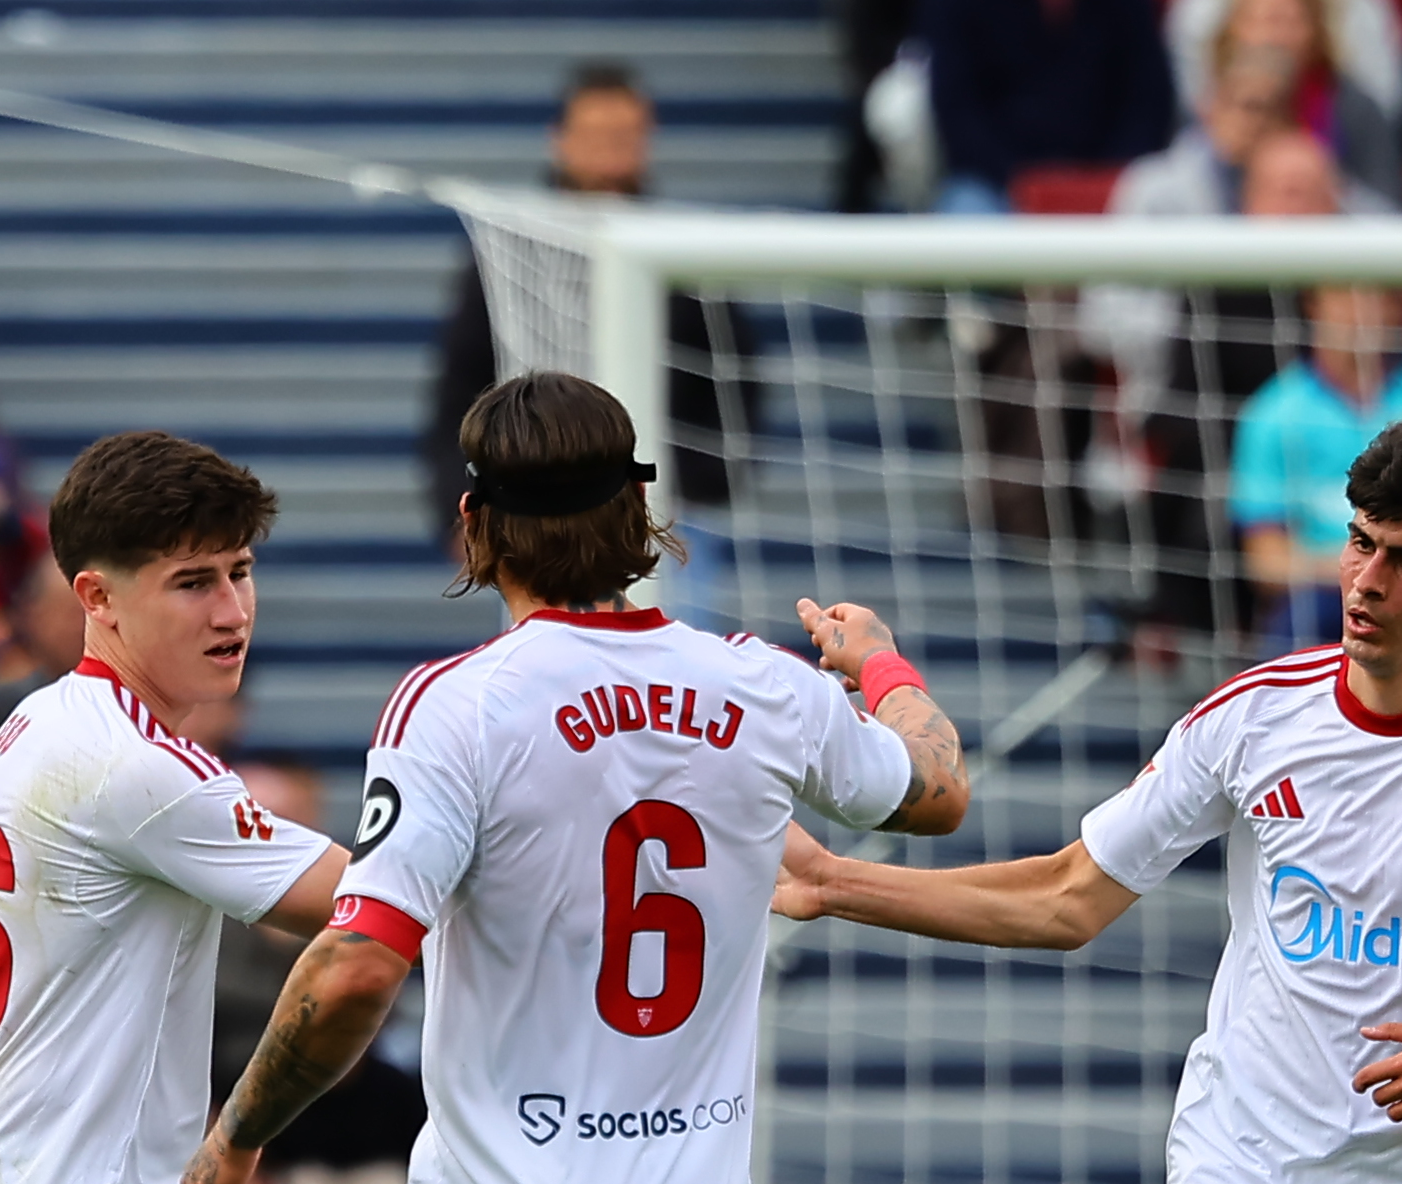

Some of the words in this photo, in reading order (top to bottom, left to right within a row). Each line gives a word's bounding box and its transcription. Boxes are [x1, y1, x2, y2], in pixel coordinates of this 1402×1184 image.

[555, 684, 745, 754] GUDELJ
[354, 797, 393, 845] D
[596, 800, 707, 1039] 6
